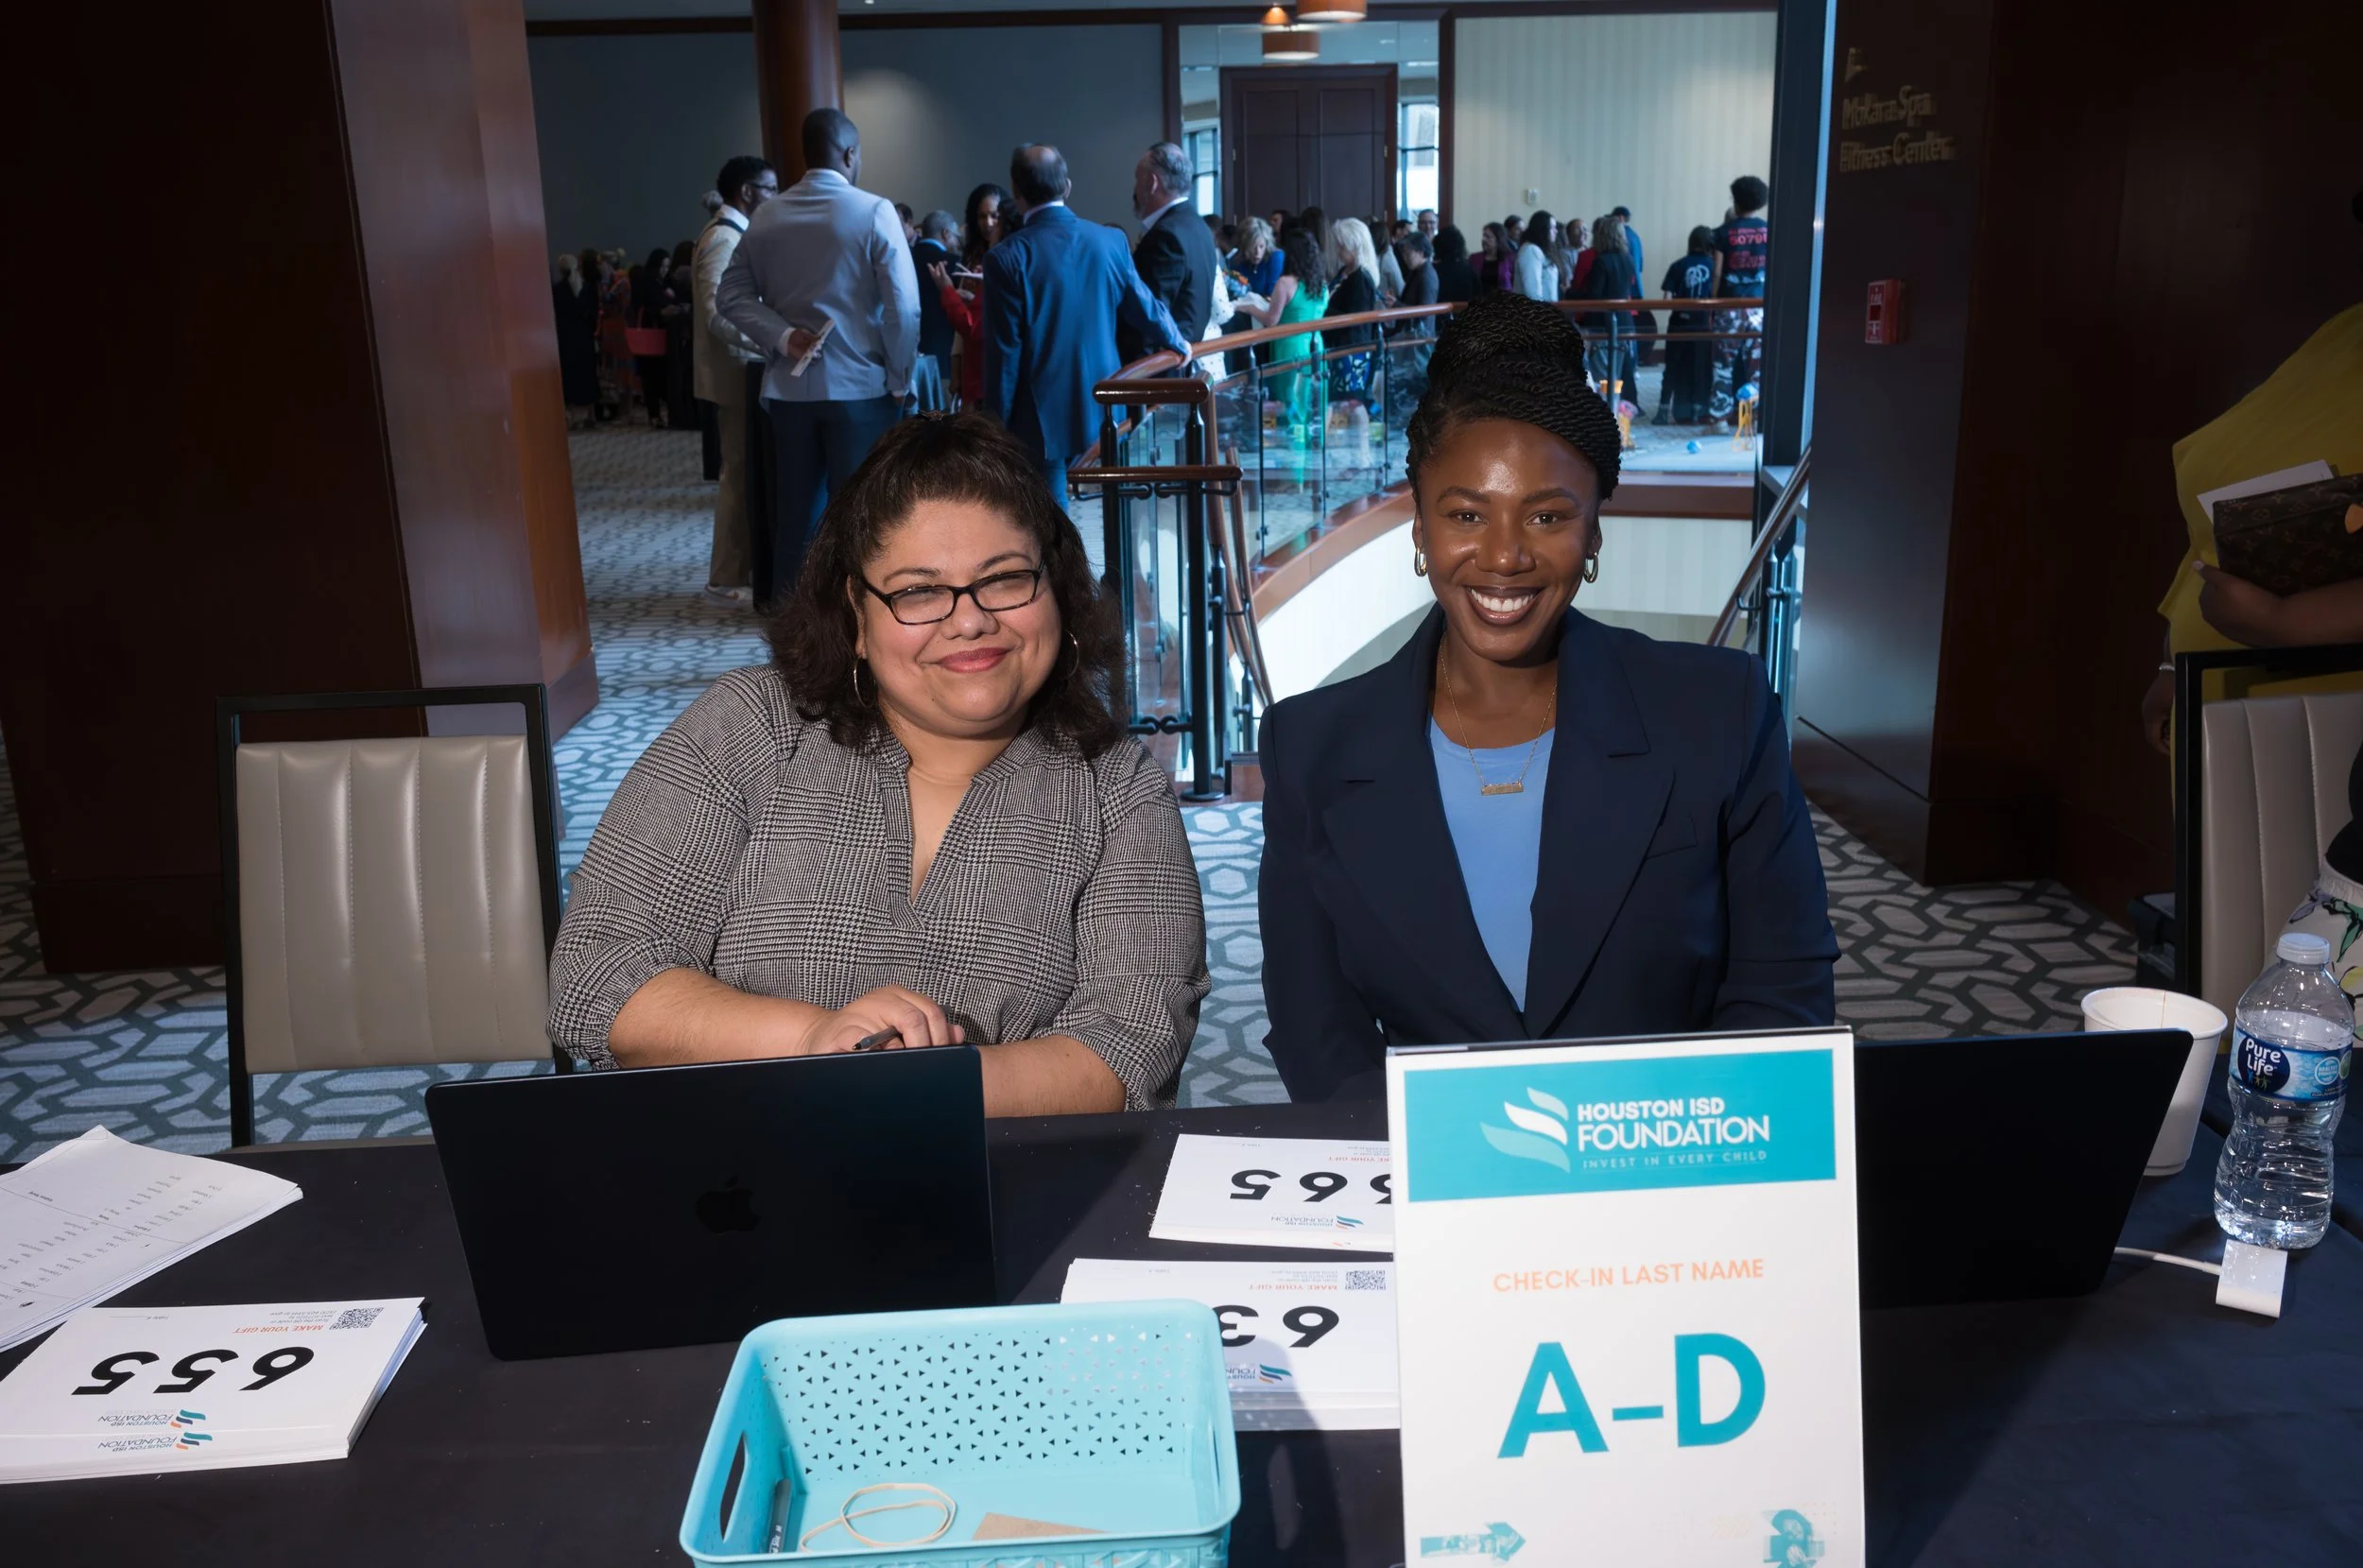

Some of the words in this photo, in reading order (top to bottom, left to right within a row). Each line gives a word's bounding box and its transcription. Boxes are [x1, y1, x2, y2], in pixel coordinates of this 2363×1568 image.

[2246, 1038, 2282, 1063] Pure
[2248, 1053, 2274, 1076] Life
[1577, 1099, 1684, 1122] HOUSTON
[1689, 1096, 1726, 1116] ISD
[1578, 1114, 1770, 1152] FOUNDATION
[1582, 1157, 1636, 1170] INVEST
[1645, 1155, 1660, 1166] IN
[1668, 1152, 1714, 1165] EVERY
[1722, 1150, 1768, 1163] CHILD
[1492, 1267, 1614, 1293] CHECK-IN
[1622, 1263, 1684, 1285] LAST
[1691, 1258, 1764, 1282] NAME
[1212, 1305, 1339, 1348] 63
[71, 1347, 315, 1395] 655
[97, 1413, 174, 1422] FOUNDATION
[97, 1437, 178, 1449] FOUNDATION
